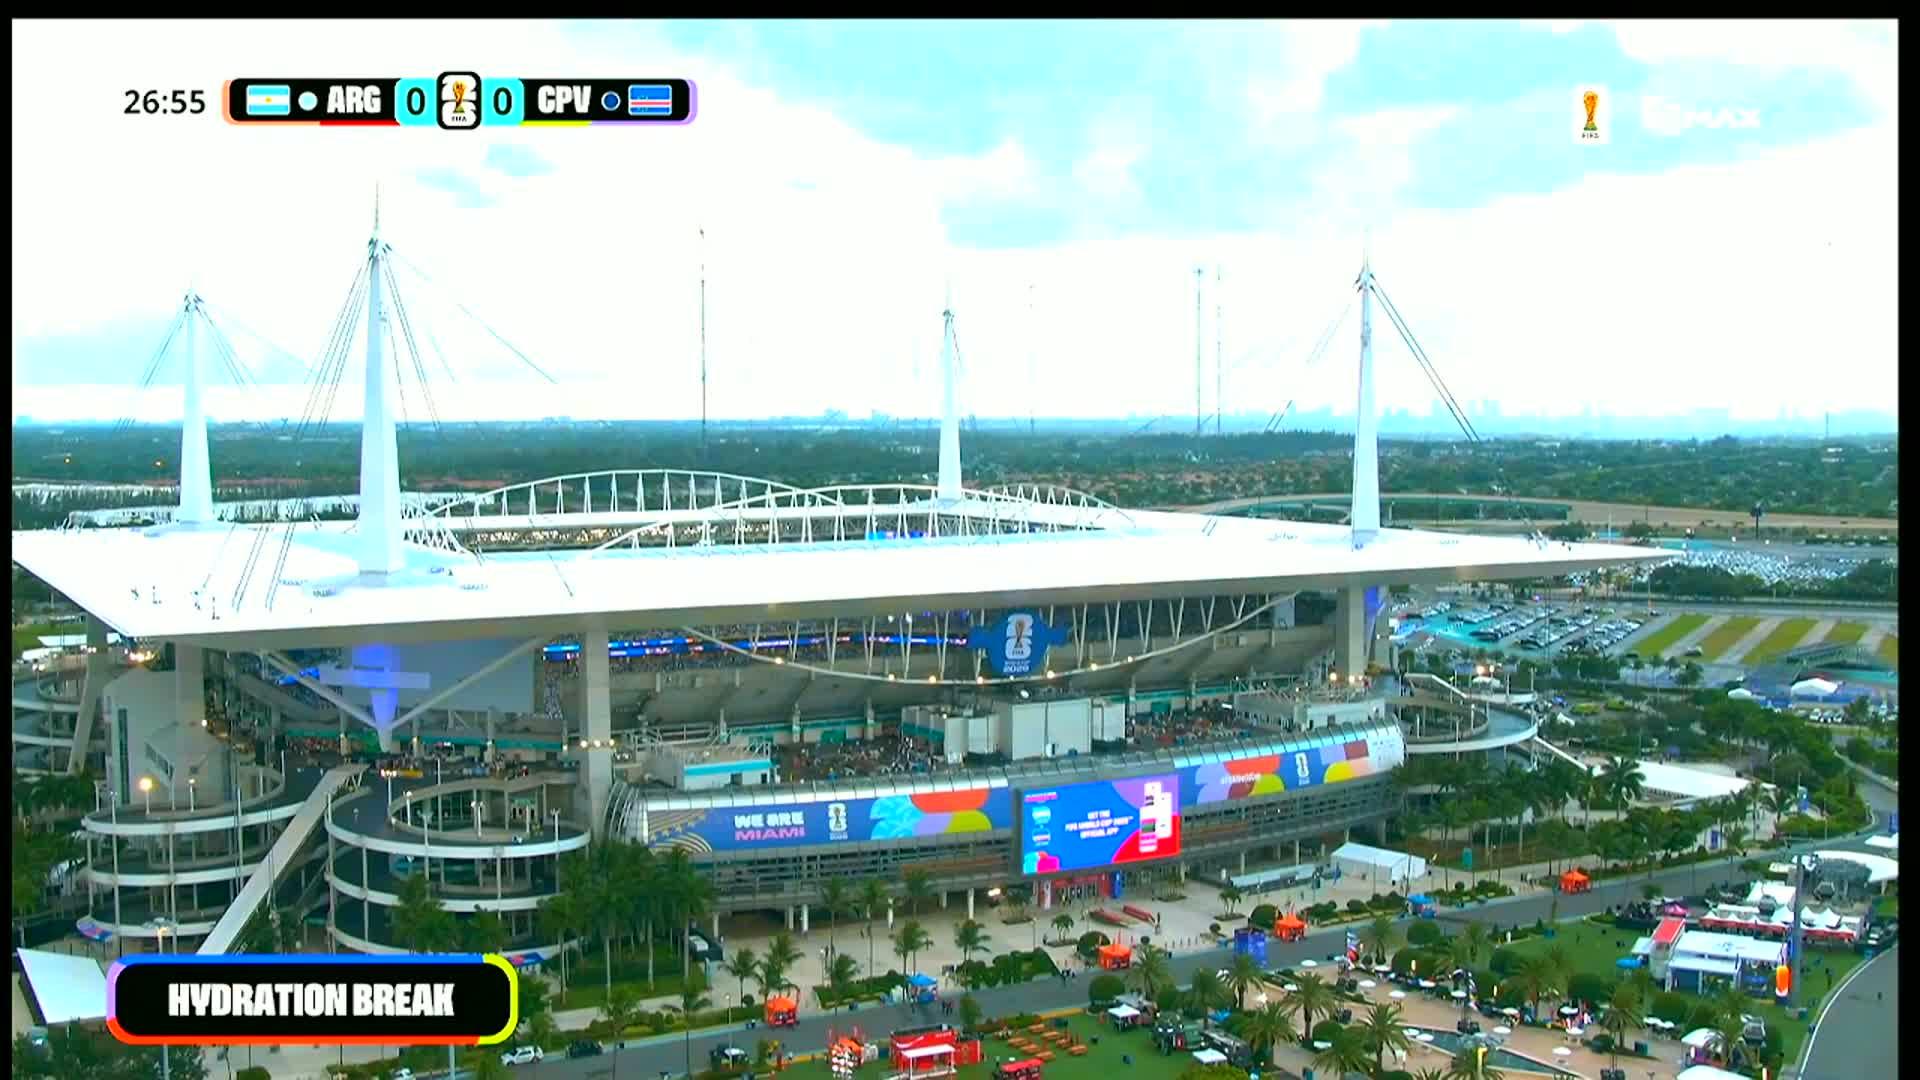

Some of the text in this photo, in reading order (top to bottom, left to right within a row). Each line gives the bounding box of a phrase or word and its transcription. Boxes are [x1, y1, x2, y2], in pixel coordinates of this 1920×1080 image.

[734, 811, 804, 829] WE ARE
[735, 826, 805, 841] MIAMI
